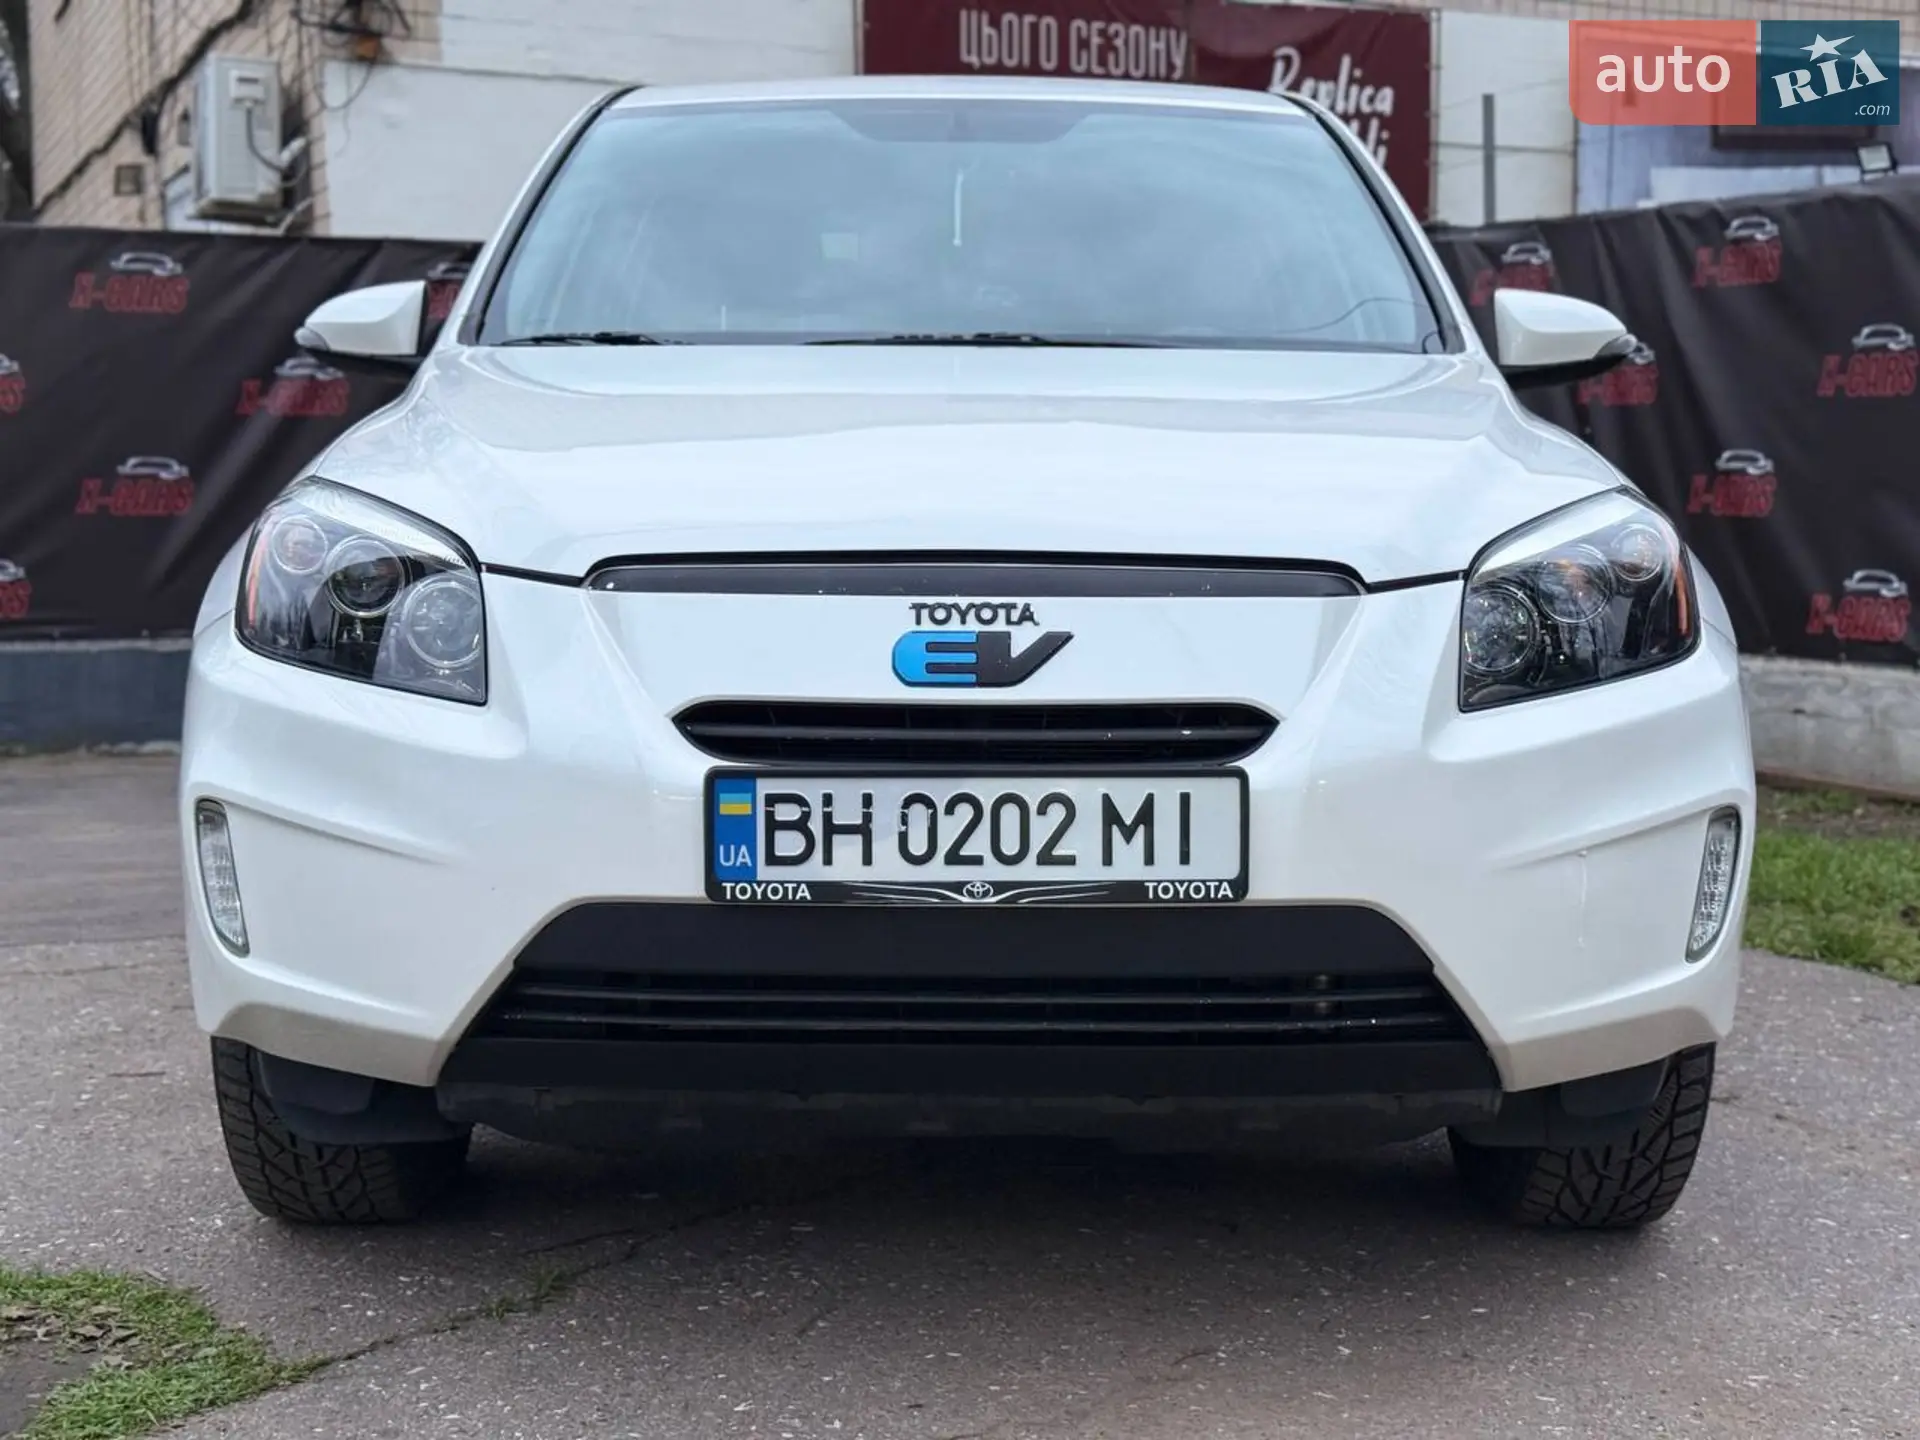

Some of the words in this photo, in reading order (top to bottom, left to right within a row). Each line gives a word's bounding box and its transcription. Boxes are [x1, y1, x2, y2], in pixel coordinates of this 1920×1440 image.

[958, 8, 1058, 71] ЦЬОГО
[1069, 18, 1187, 80] СЕЗОНУ
[909, 602, 1040, 626] TOYOTA
[892, 630, 1075, 688] EV
[764, 792, 874, 867] BH
[898, 791, 1076, 867] 0202
[1101, 791, 1191, 867] MI
[719, 845, 752, 867] UA
[722, 882, 812, 900] TOYOTA
[1144, 881, 1234, 899] TOYOTA
